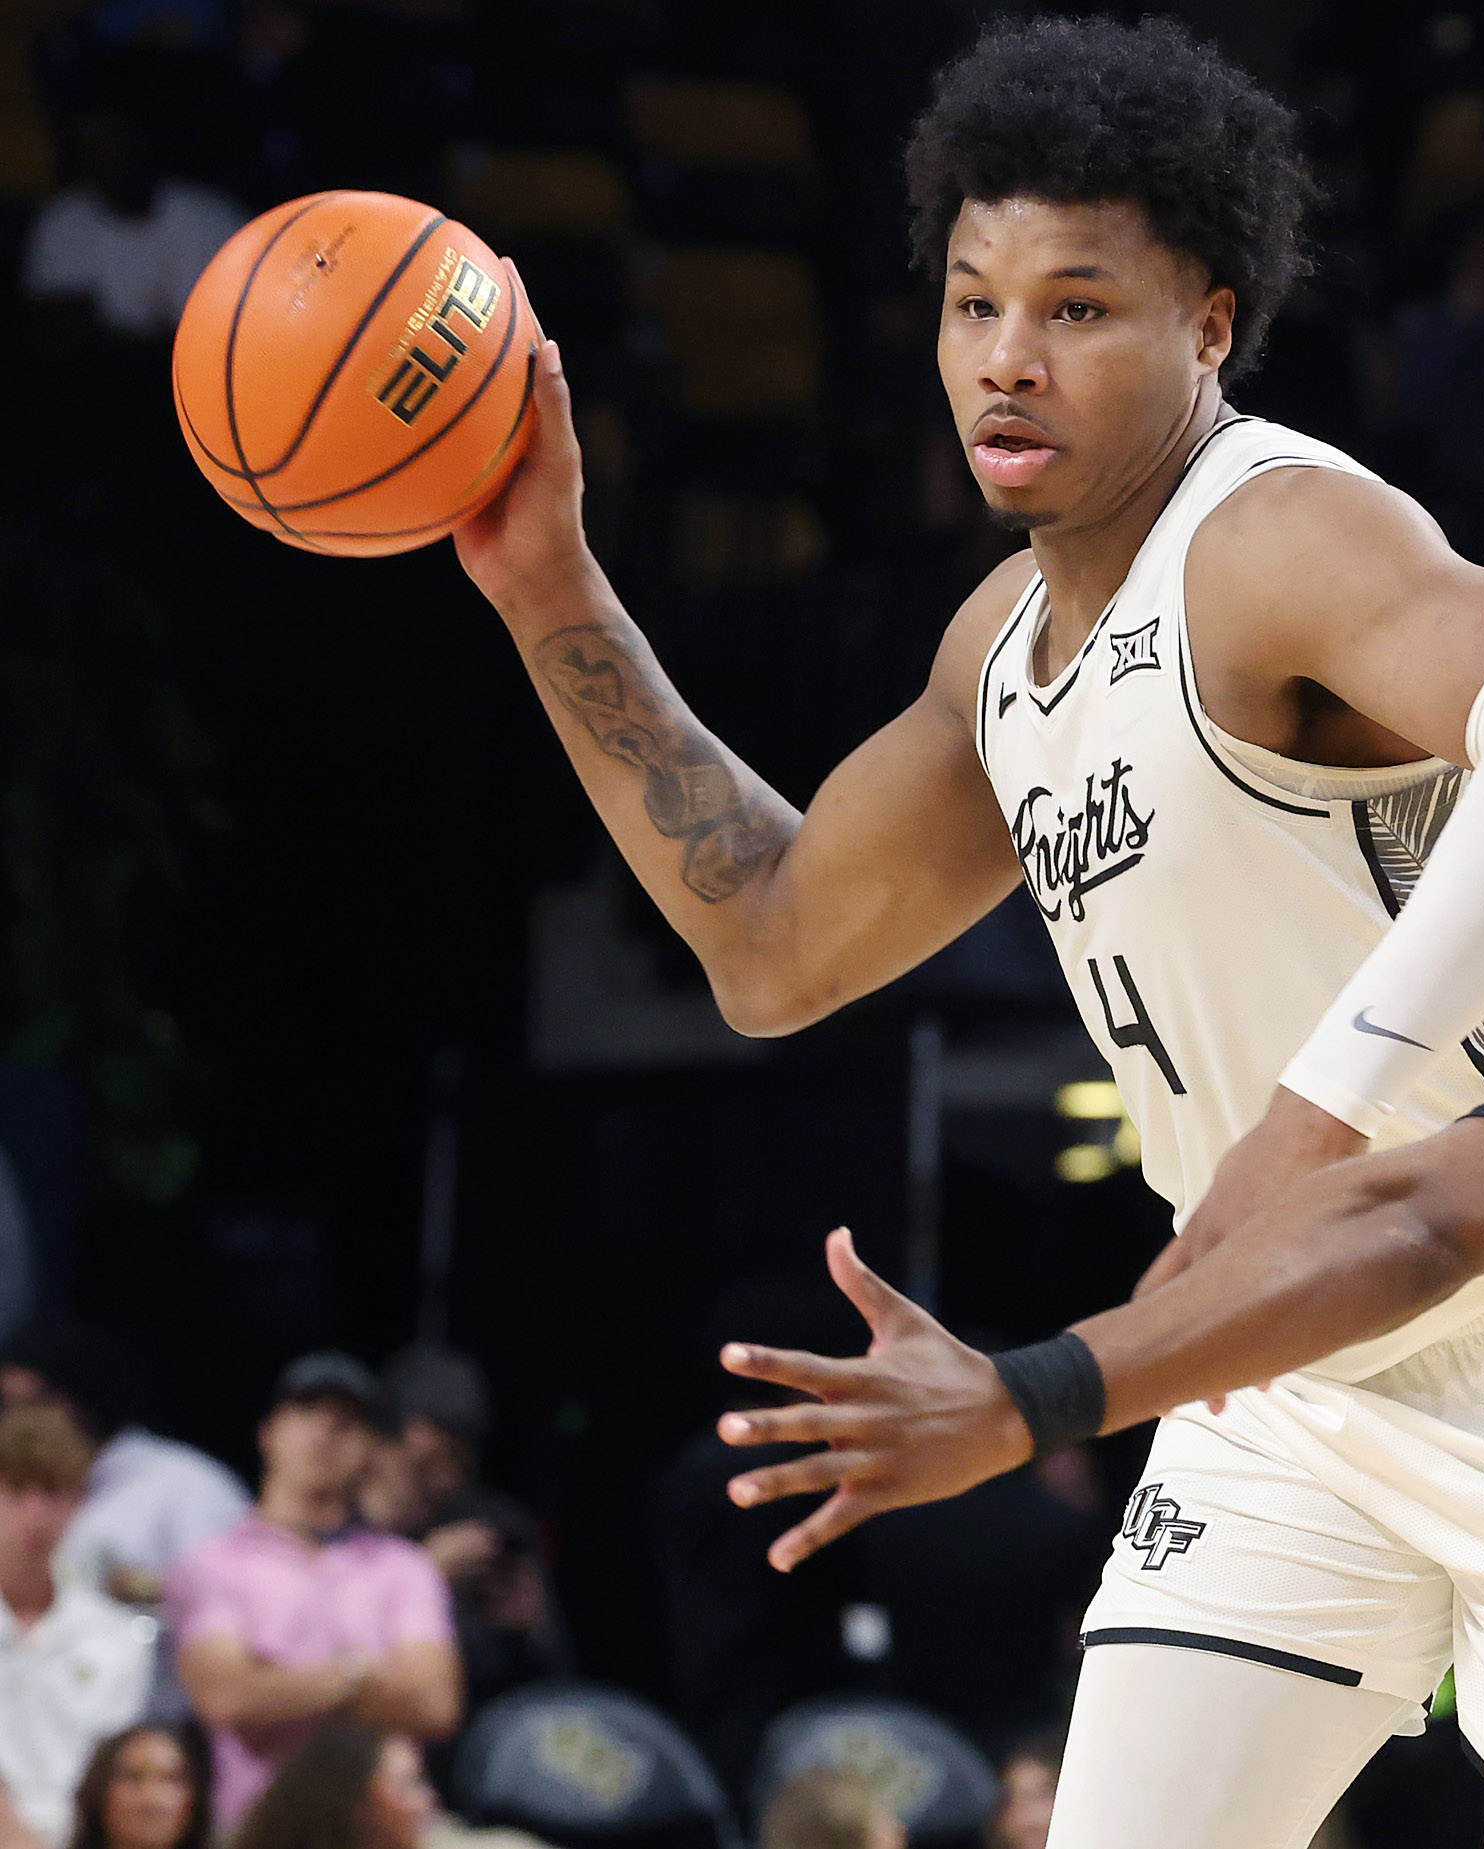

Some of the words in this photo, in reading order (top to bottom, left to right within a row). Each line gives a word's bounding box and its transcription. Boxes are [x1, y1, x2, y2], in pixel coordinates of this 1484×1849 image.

[373, 255, 502, 428] ELITE
[1110, 616, 1161, 686] XII
[1012, 756, 1156, 922] Knights
[1087, 954, 1188, 1095] 4
[1121, 1482, 1208, 1571] UCF
